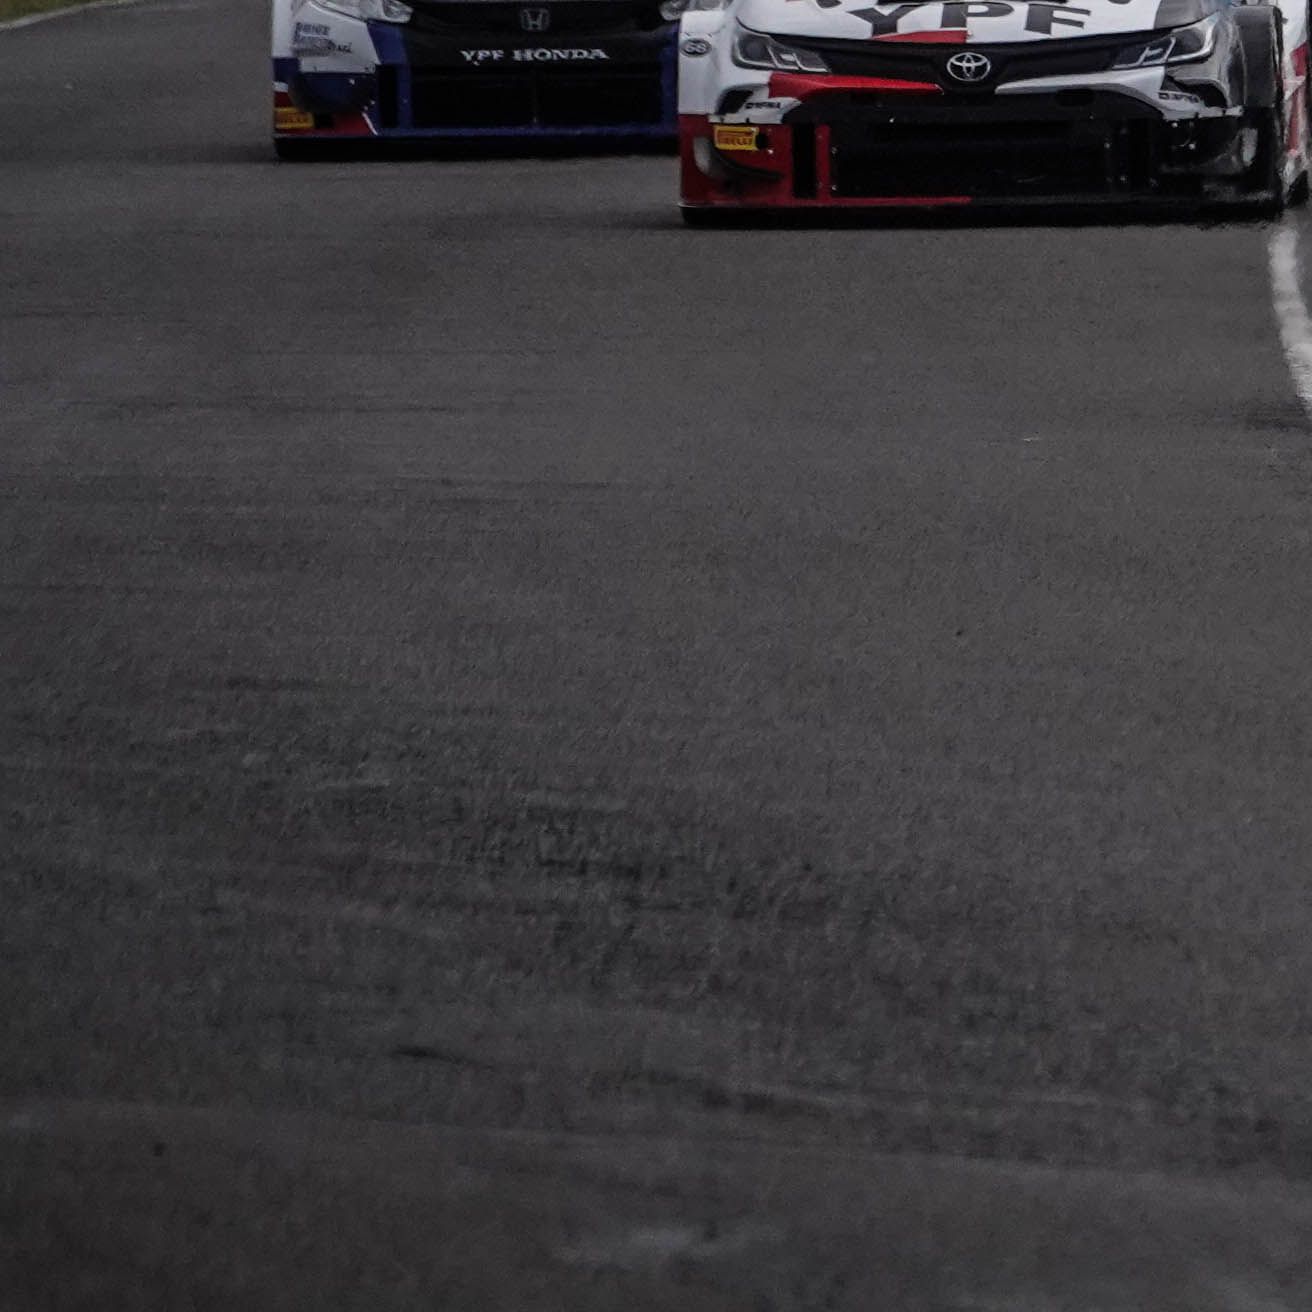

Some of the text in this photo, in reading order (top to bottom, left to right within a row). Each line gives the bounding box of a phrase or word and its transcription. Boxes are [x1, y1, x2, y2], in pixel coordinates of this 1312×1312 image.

[845, 1, 1093, 39] YPF
[460, 48, 610, 64] YPF HONDA
